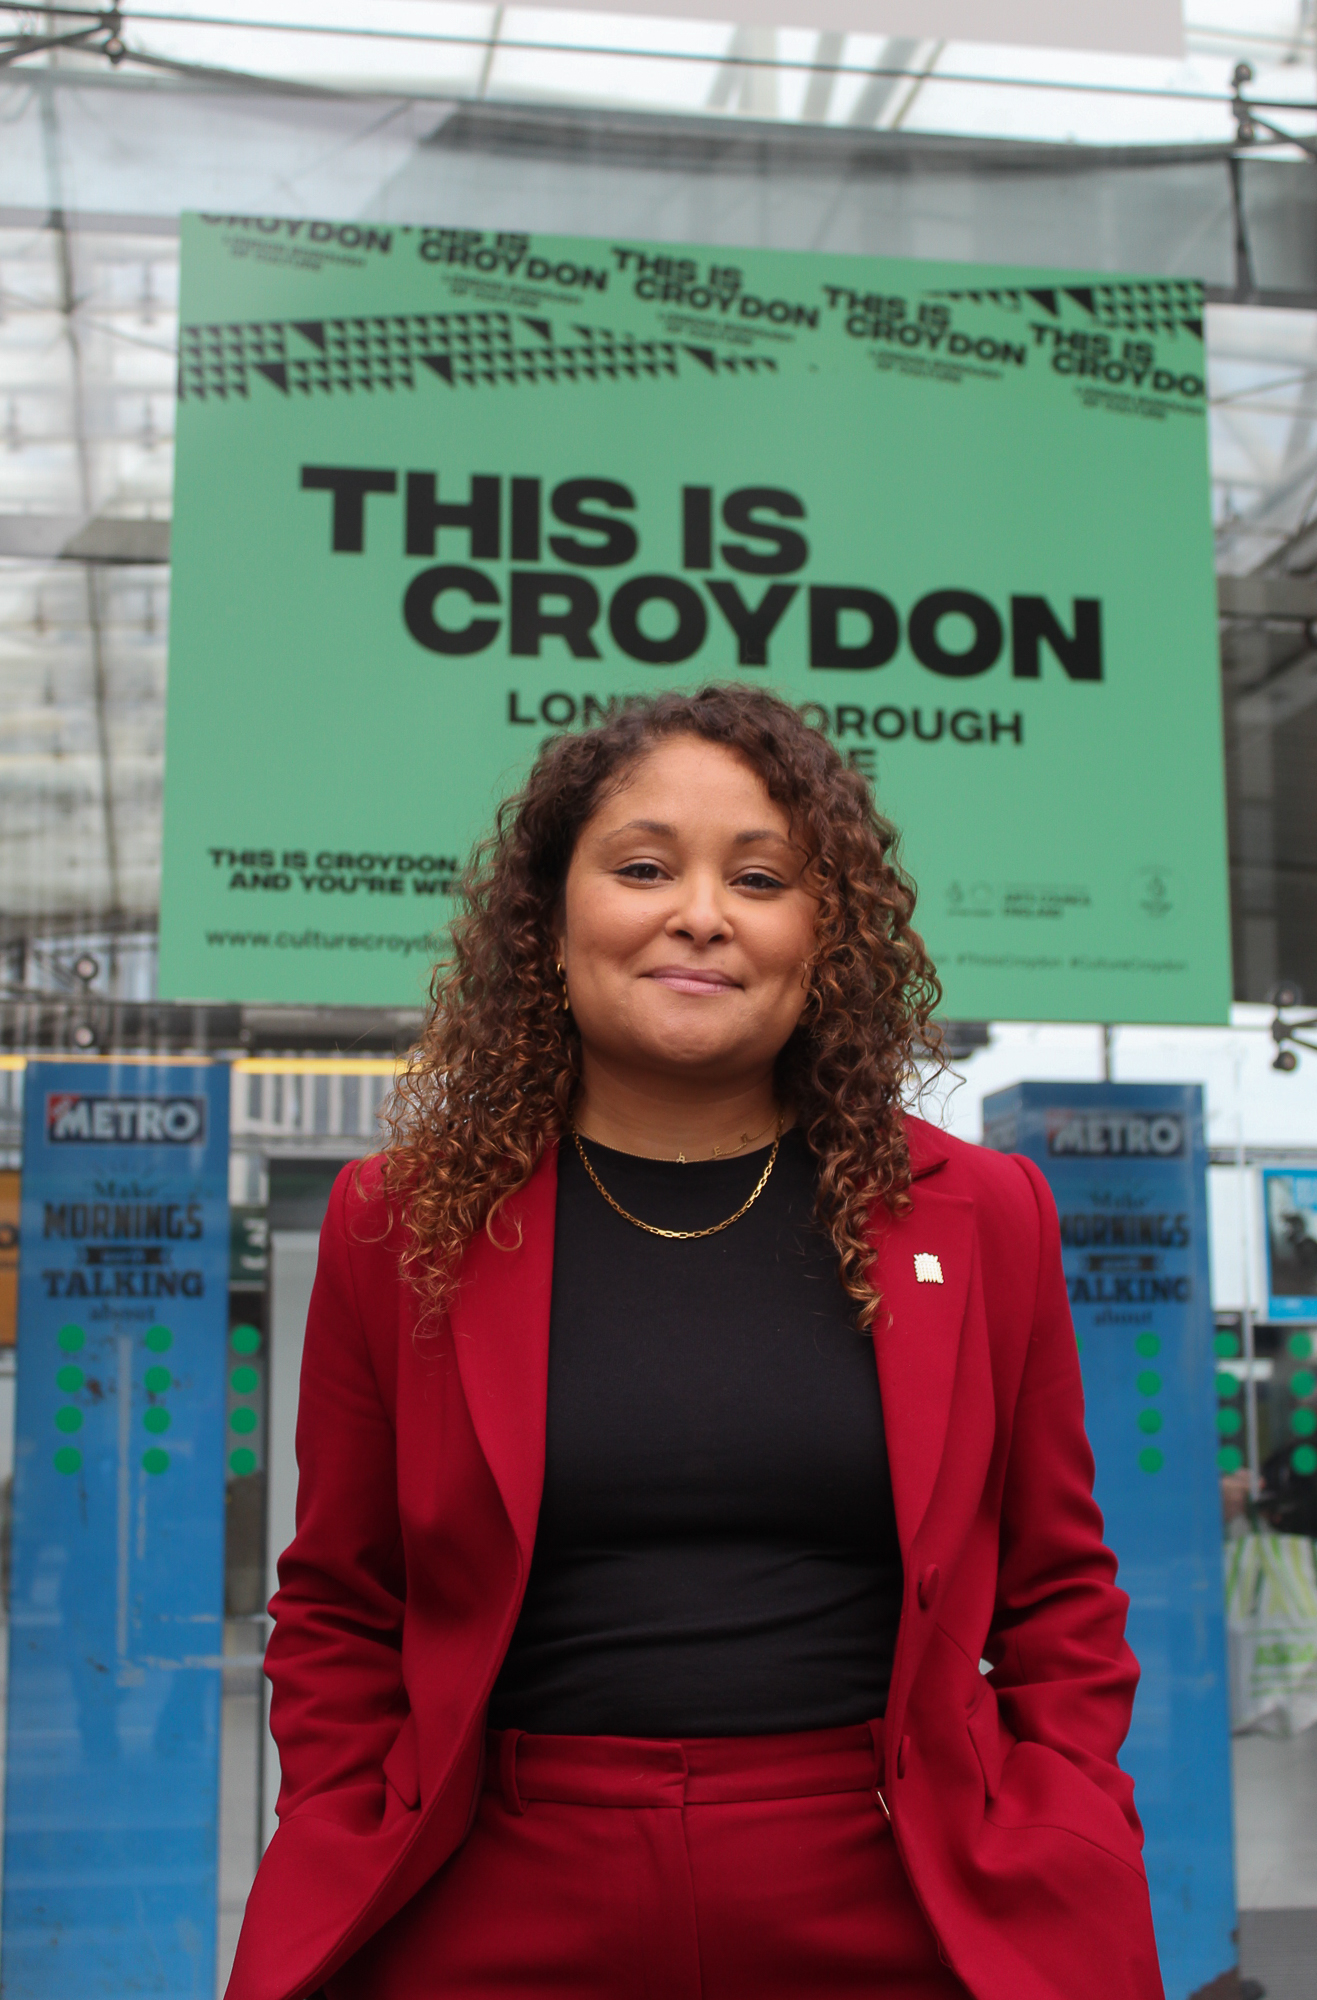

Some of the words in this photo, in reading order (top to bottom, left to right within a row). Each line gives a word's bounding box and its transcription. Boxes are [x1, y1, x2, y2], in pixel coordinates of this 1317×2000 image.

[419, 238, 608, 293] CROYDON
[611, 247, 698, 284] THIS
[709, 264, 743, 291] IS
[634, 275, 820, 330] CROYDON
[822, 284, 907, 323] THIS
[918, 303, 951, 329] IS
[844, 314, 1027, 367] CROYDON
[1029, 321, 1112, 359] THIS
[1123, 340, 1155, 366] IS
[300, 465, 640, 569] THIS
[682, 484, 809, 577] IS
[402, 563, 1105, 683] CROYDON
[508, 691, 640, 728] LON
[800, 704, 1023, 745] OROUGH
[207, 848, 275, 869] THIS
[282, 850, 308, 870] IS
[229, 872, 291, 892] AND
[299, 873, 404, 895] YOU'RE
[412, 876, 453, 896] WE
[53, 1099, 201, 1142] METRO
[1054, 1115, 1182, 1155] METRO
[43, 1202, 204, 1240] MORNINGS
[42, 1270, 205, 1298] TALKING
[1064, 1276, 1191, 1303] ALKING
